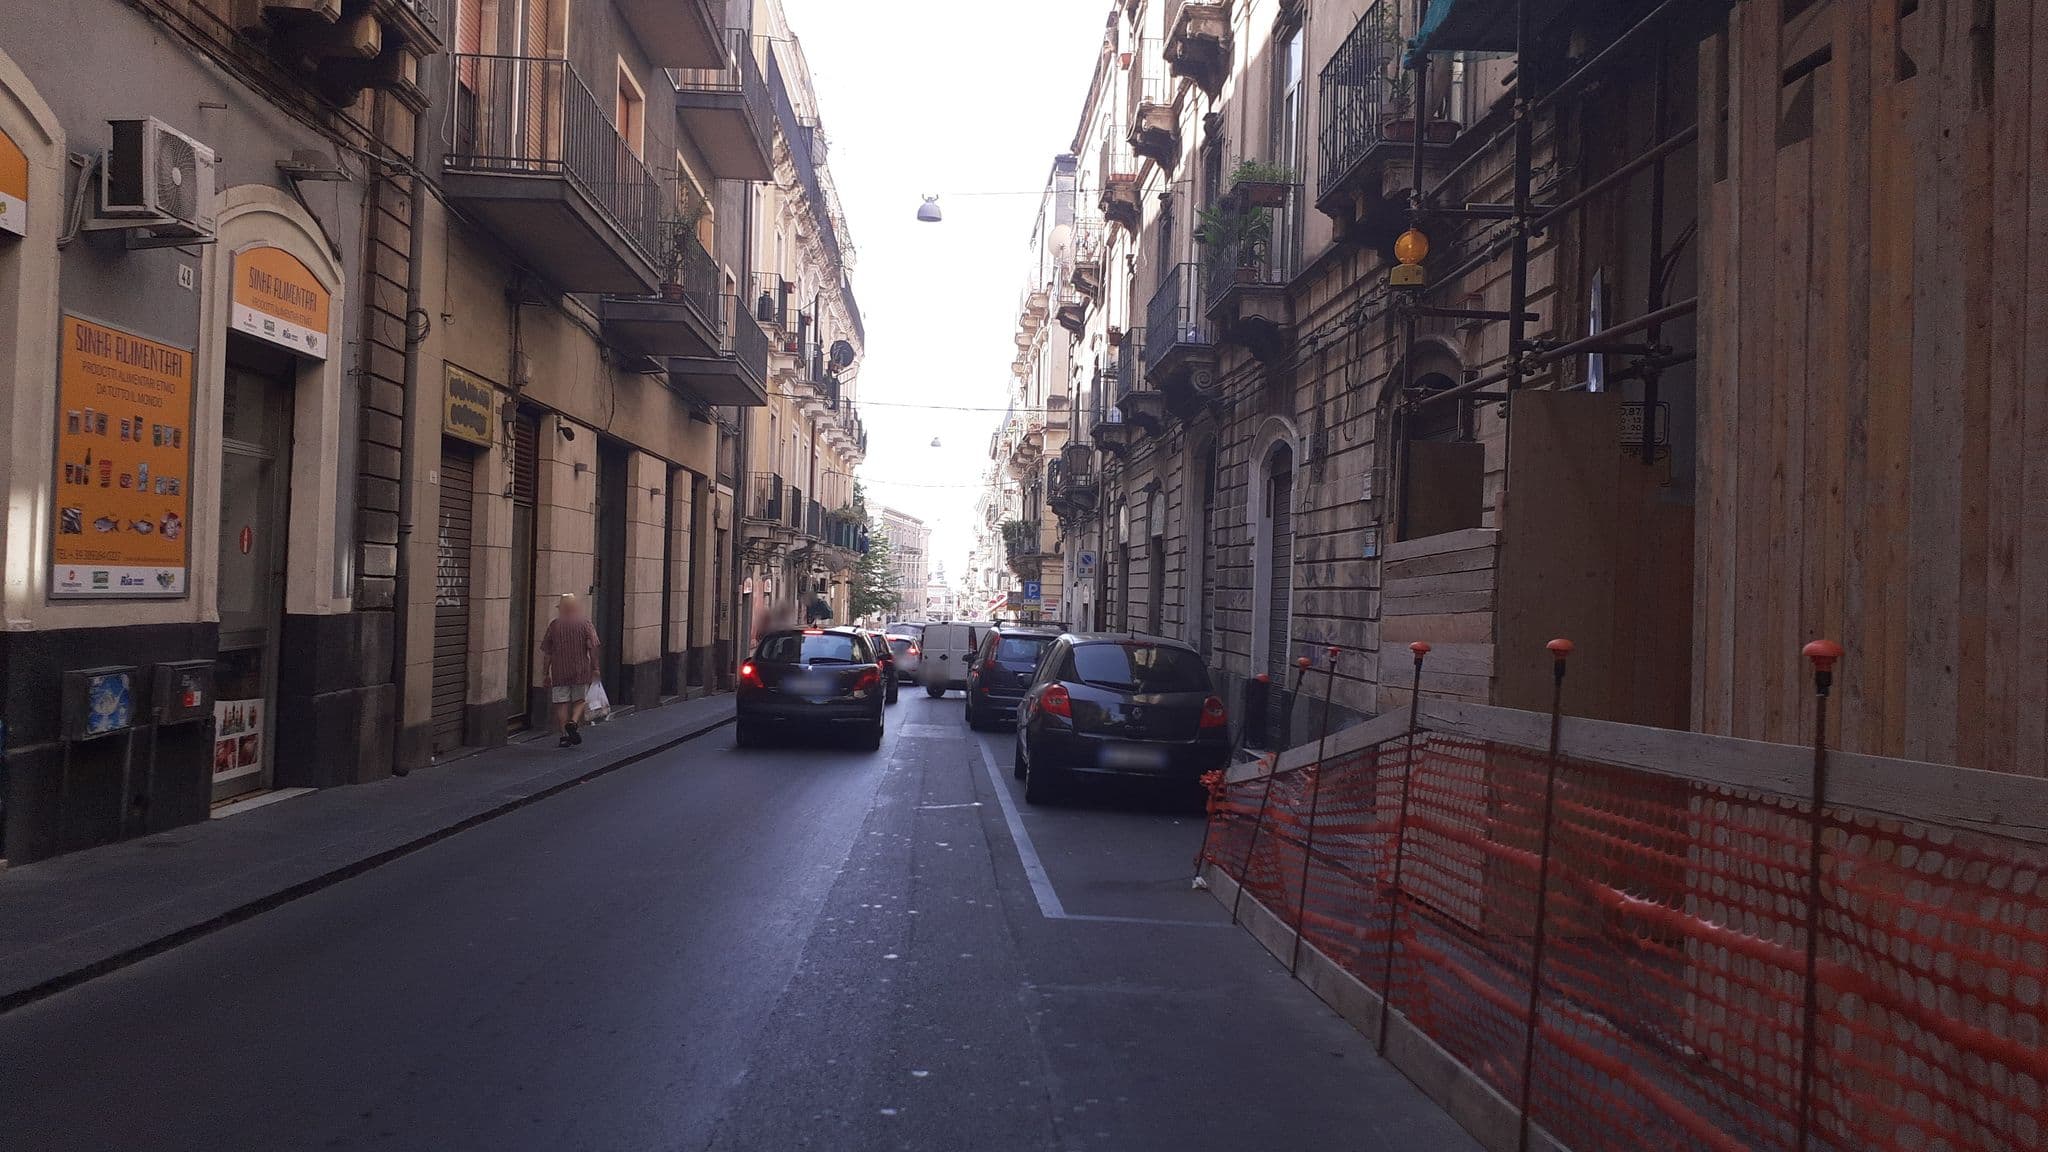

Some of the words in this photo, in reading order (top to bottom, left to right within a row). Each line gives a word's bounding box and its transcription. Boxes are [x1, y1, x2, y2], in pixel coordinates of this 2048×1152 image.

[182, 267, 191, 286] 48
[248, 266, 273, 295] SINHA
[273, 277, 318, 312] ALIMENTARI
[76, 323, 112, 358] SINHA
[115, 335, 183, 378] ALIMENTARI
[81, 360, 118, 378] PRODOTTI
[118, 370, 155, 388] ALIMENTARI
[156, 379, 177, 394] ETNICI
[96, 382, 106, 395] DA
[107, 385, 130, 401] TUTTO
[138, 392, 164, 408] MONDO
[1028, 583, 1038, 596] P
